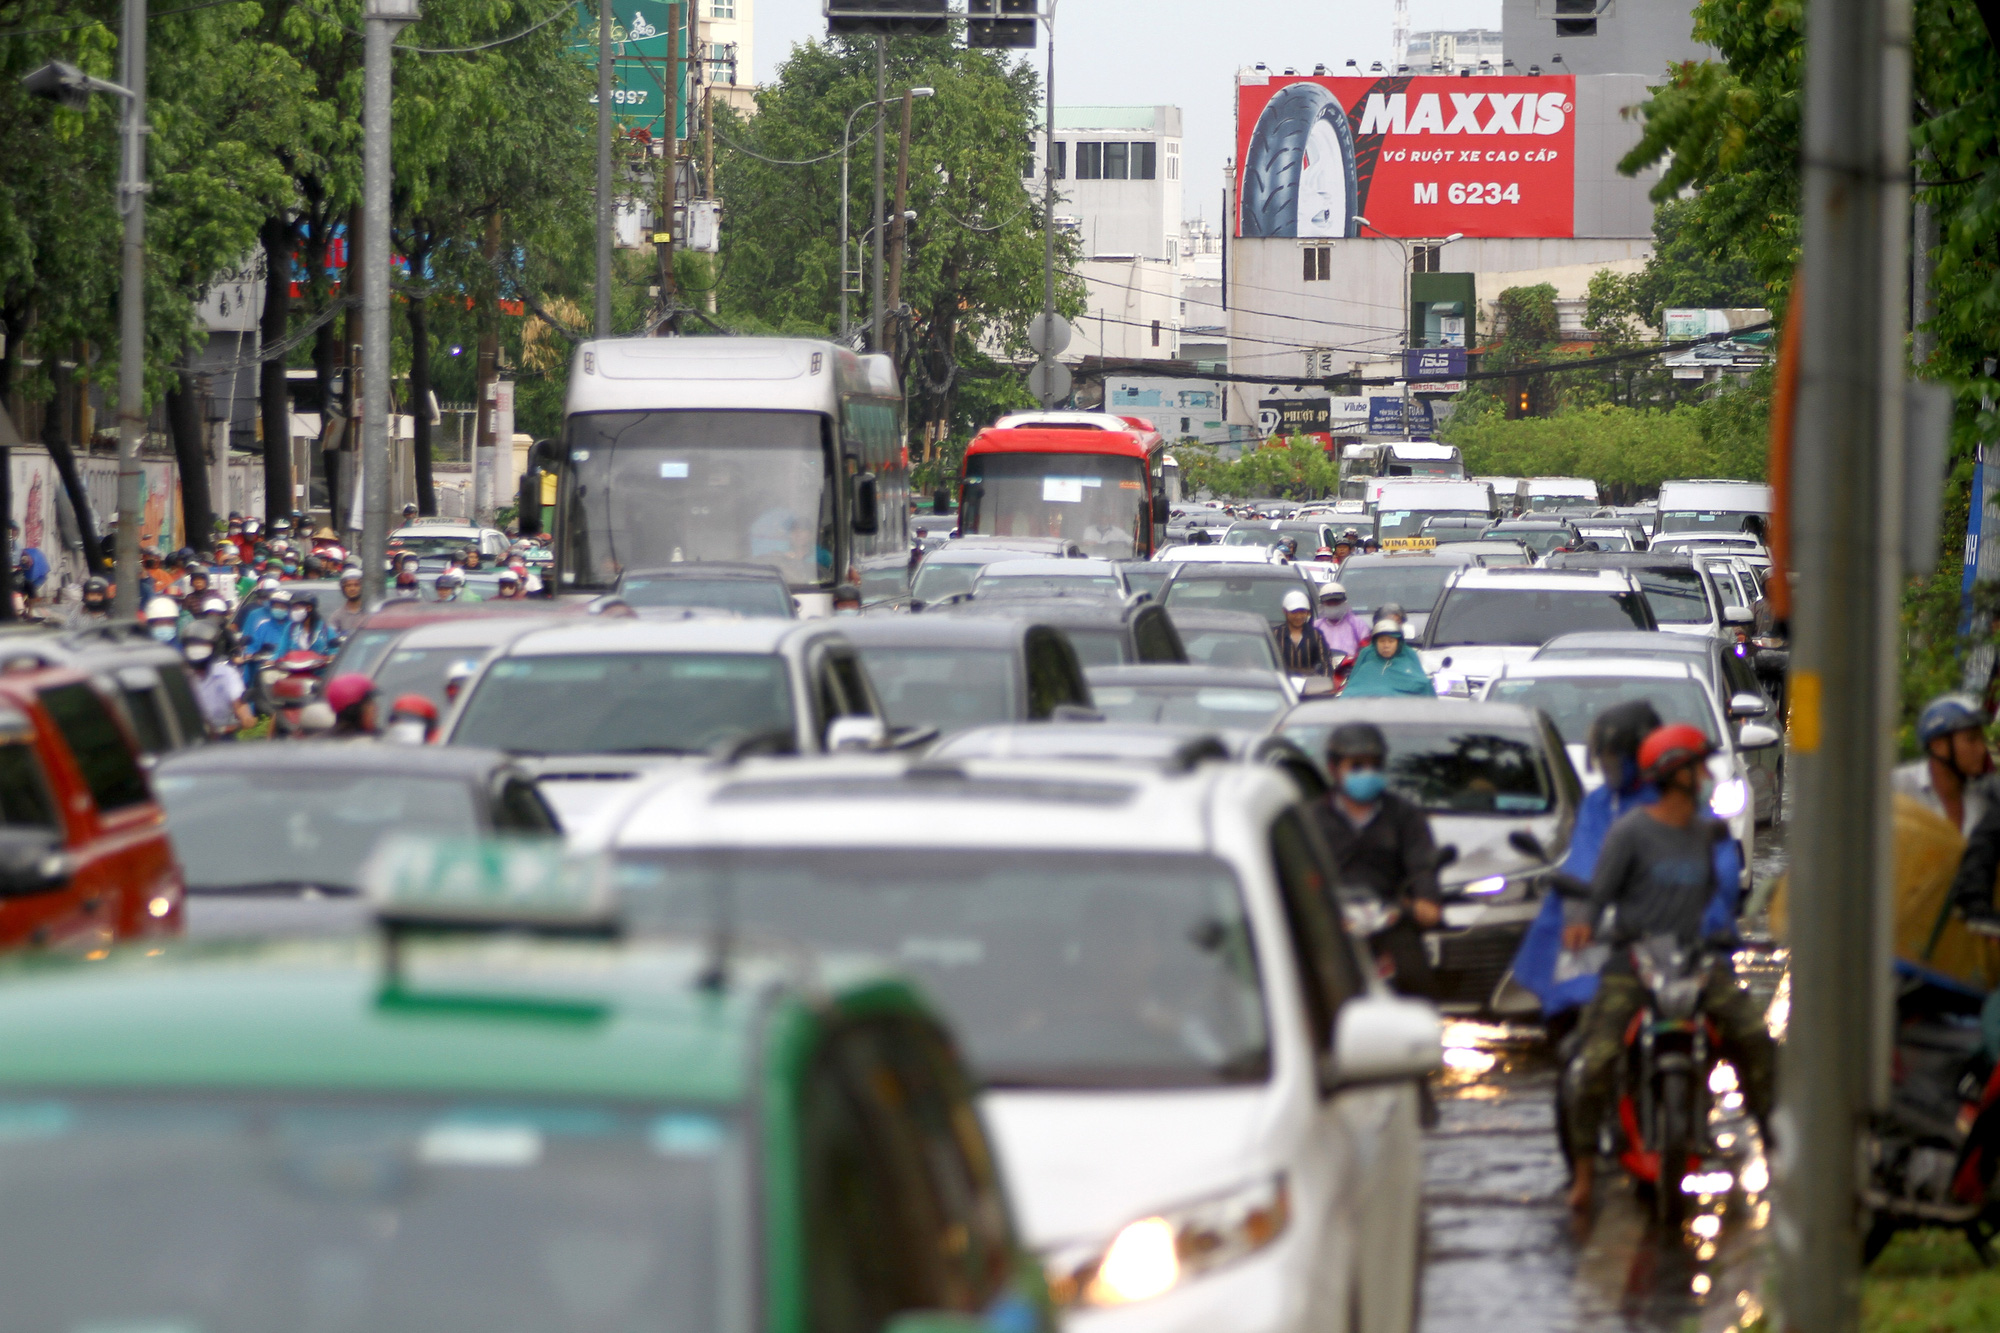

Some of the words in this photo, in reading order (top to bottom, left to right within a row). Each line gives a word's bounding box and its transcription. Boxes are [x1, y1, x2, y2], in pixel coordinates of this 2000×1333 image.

[1358, 92, 1567, 135] MAXXIS
[1410, 148, 1455, 165] RUỘT
[1458, 150, 1481, 162] XE
[1485, 150, 1520, 162] CAO
[1413, 182, 1438, 204] M
[1447, 182, 1521, 205] 6234
[1419, 353, 1449, 367] ASUS
[1384, 539, 1408, 547] VINA
[1412, 538, 1435, 546] TAXI
